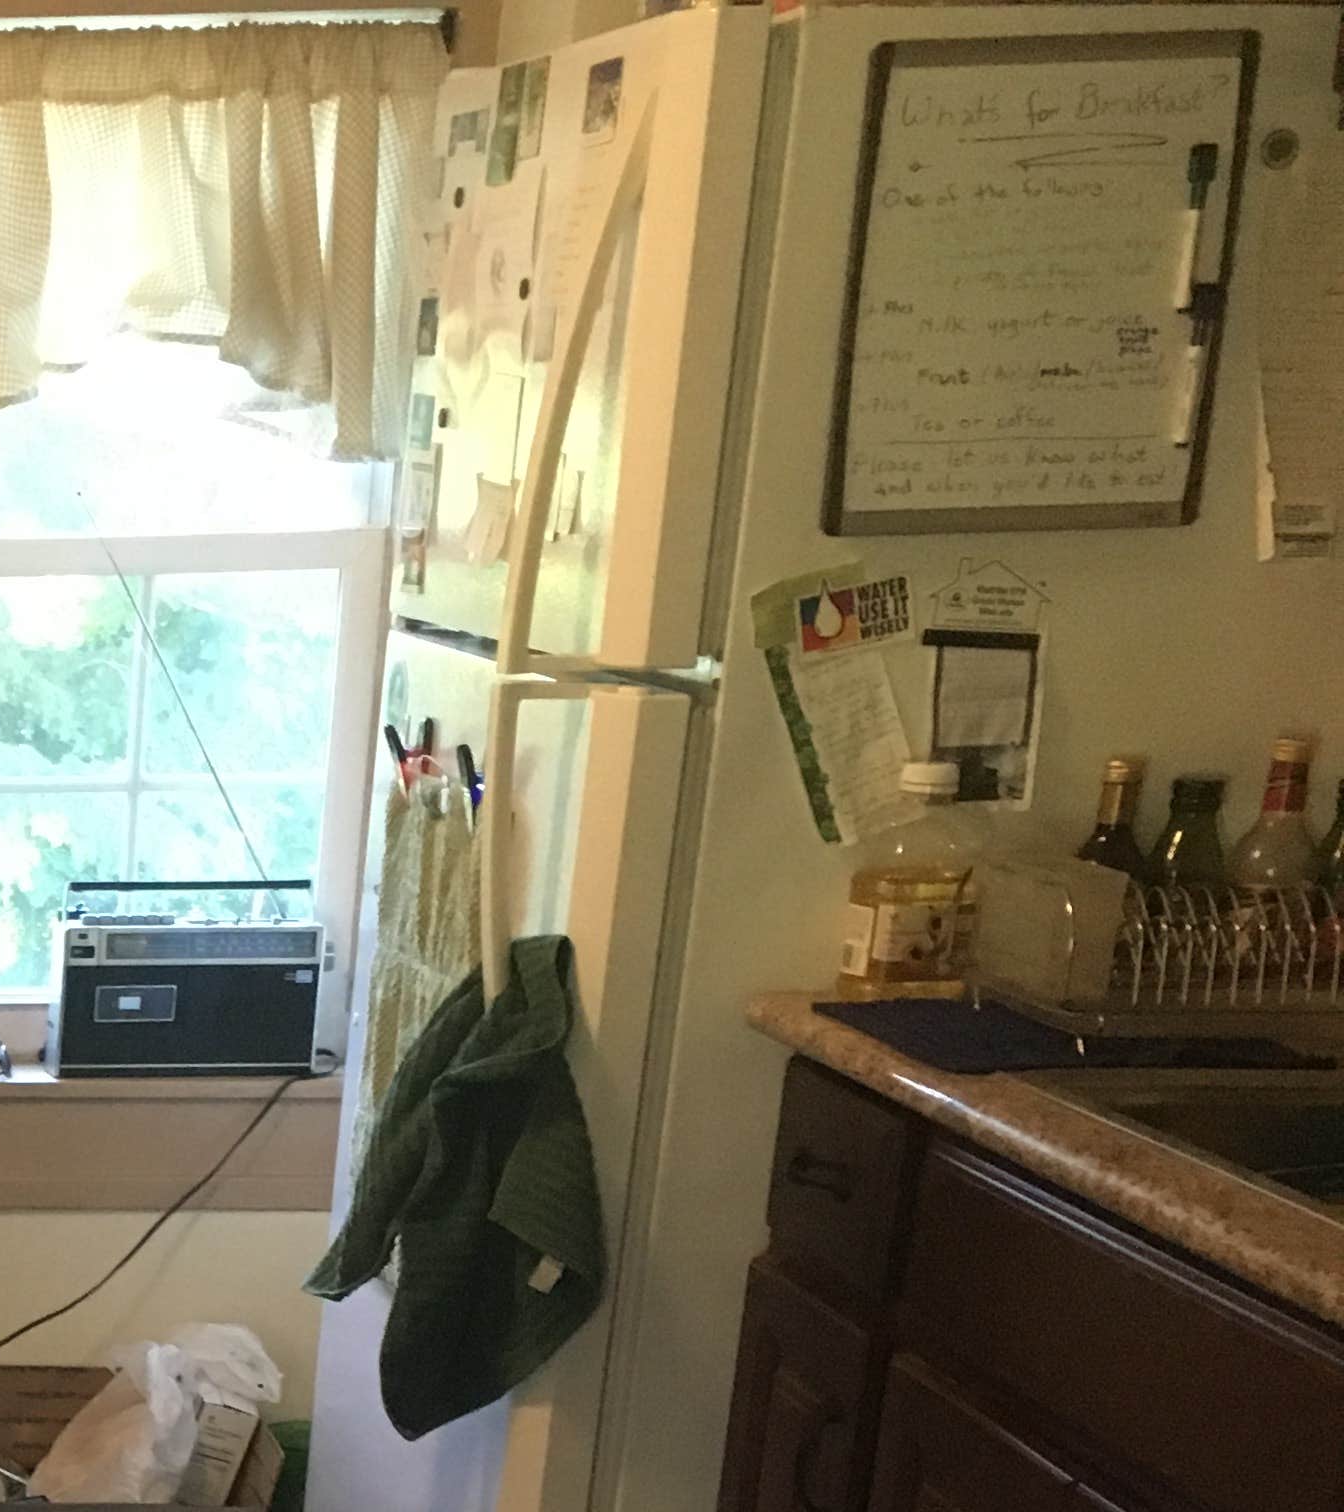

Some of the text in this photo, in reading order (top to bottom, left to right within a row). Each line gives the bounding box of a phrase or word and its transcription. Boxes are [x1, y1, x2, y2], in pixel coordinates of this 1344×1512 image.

[1025, 88, 1060, 129] for
[856, 575, 909, 602] WATER
[858, 596, 910, 625] USE IT
[859, 616, 911, 640] WISELY
